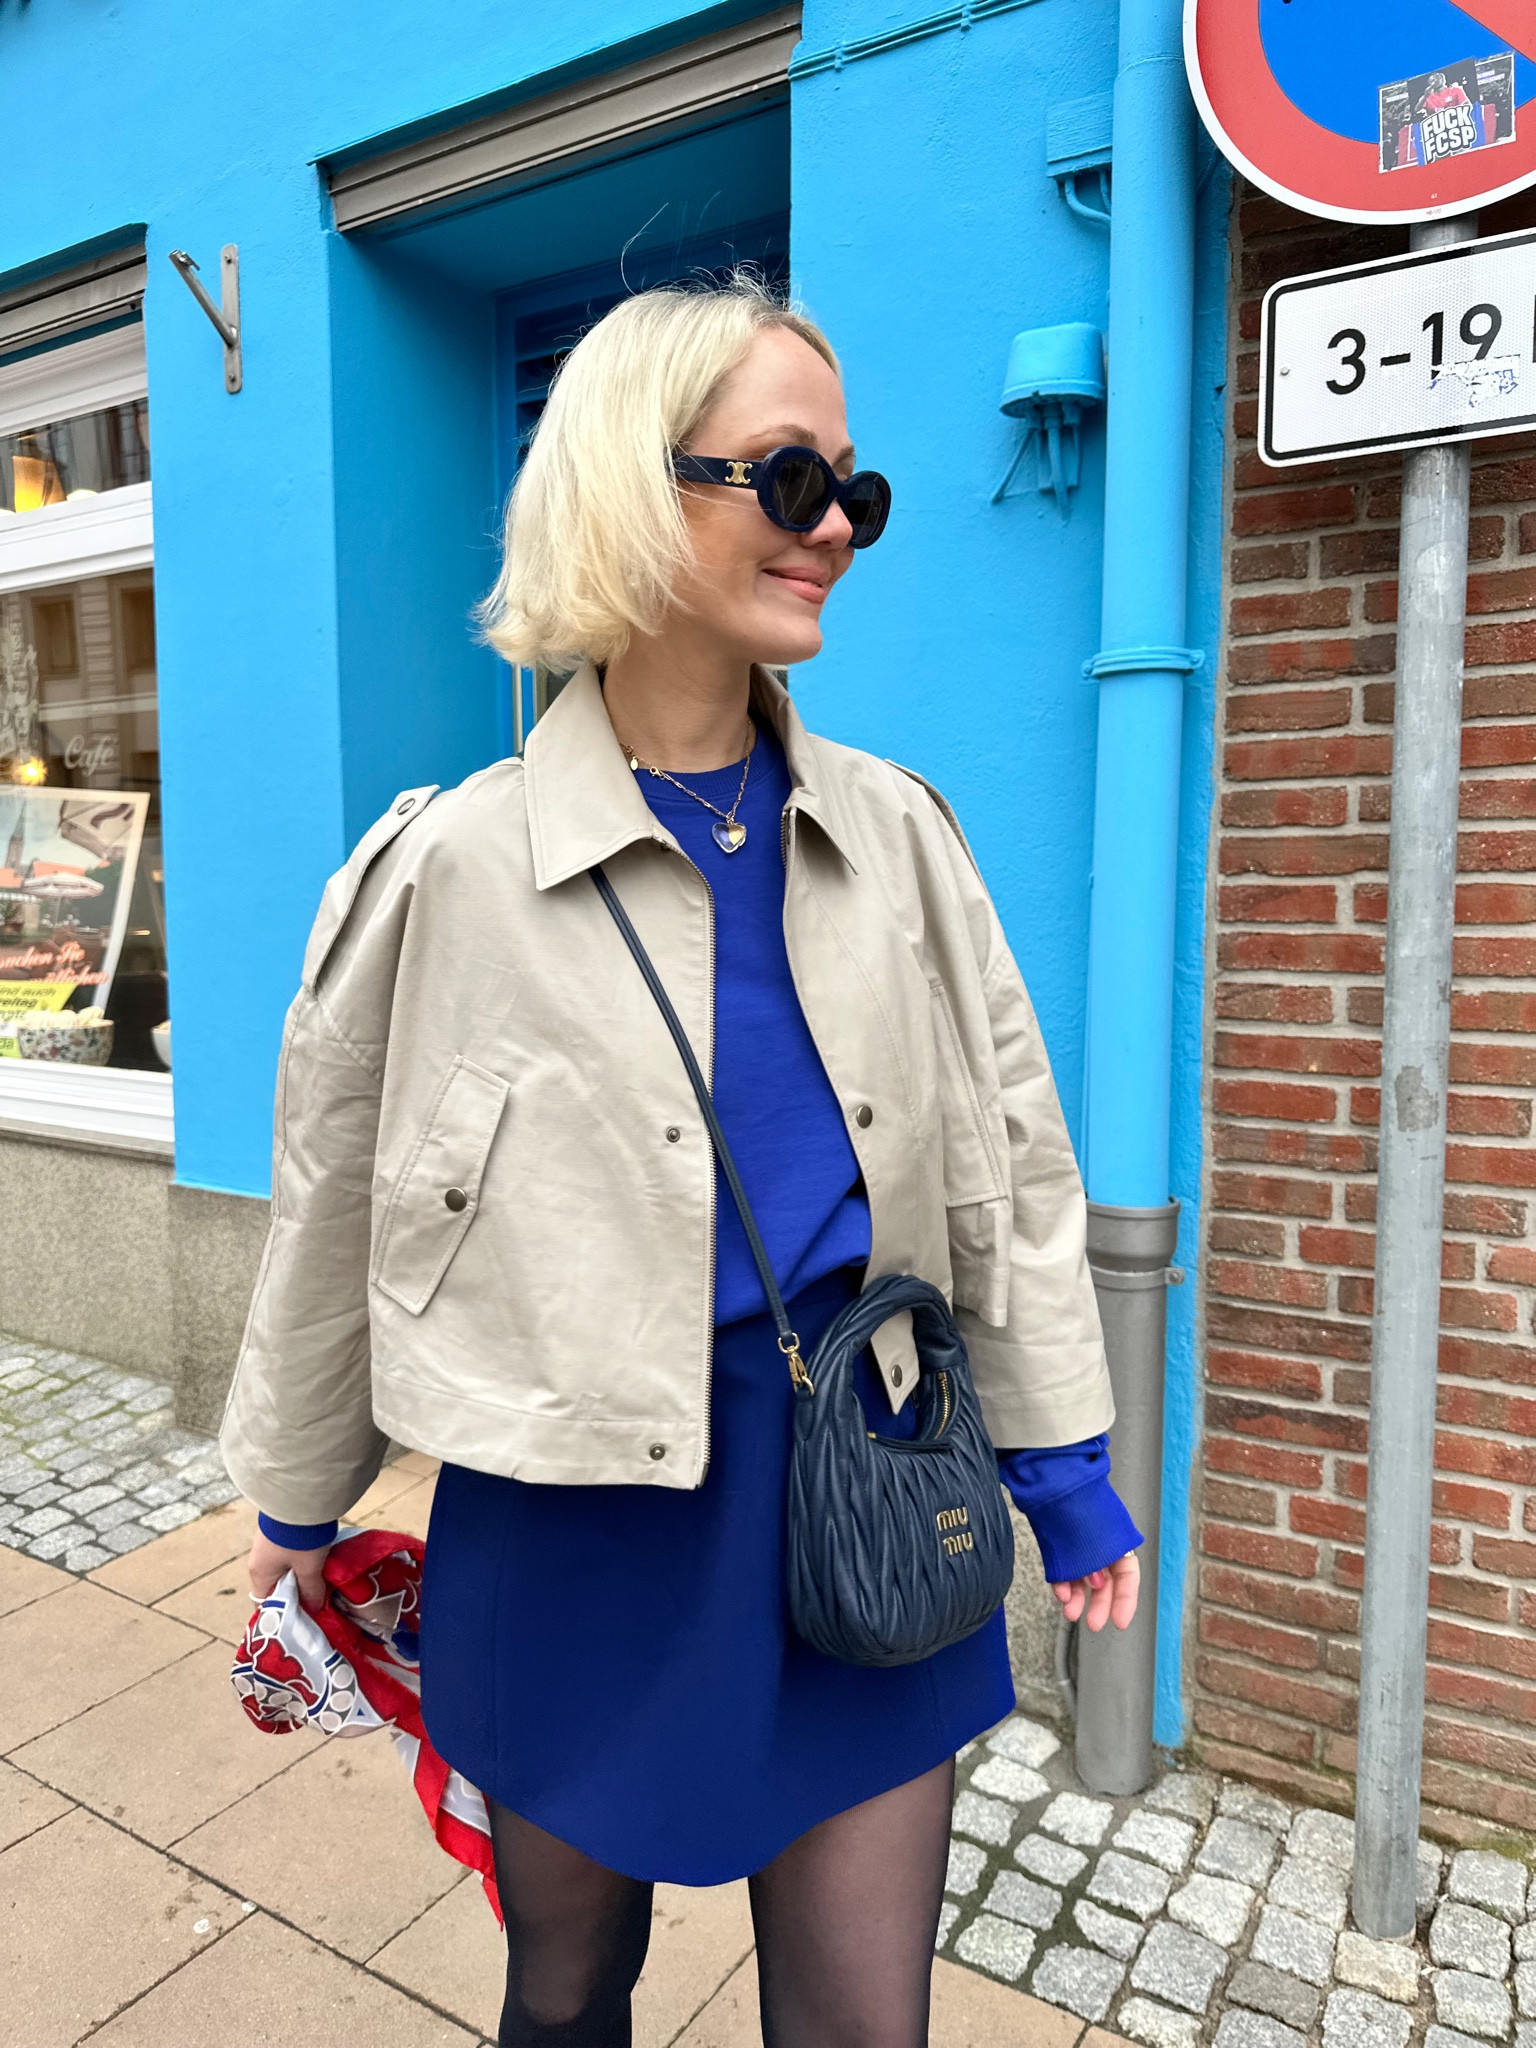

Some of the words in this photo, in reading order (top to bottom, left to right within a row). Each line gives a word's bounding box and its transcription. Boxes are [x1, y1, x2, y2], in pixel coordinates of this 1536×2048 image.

[1421, 105, 1472, 139] FUCK
[1424, 126, 1475, 162] FCSP
[1326, 303, 1503, 396] 3-19
[936, 1506, 969, 1532] MIU
[942, 1532, 974, 1556] MIU
